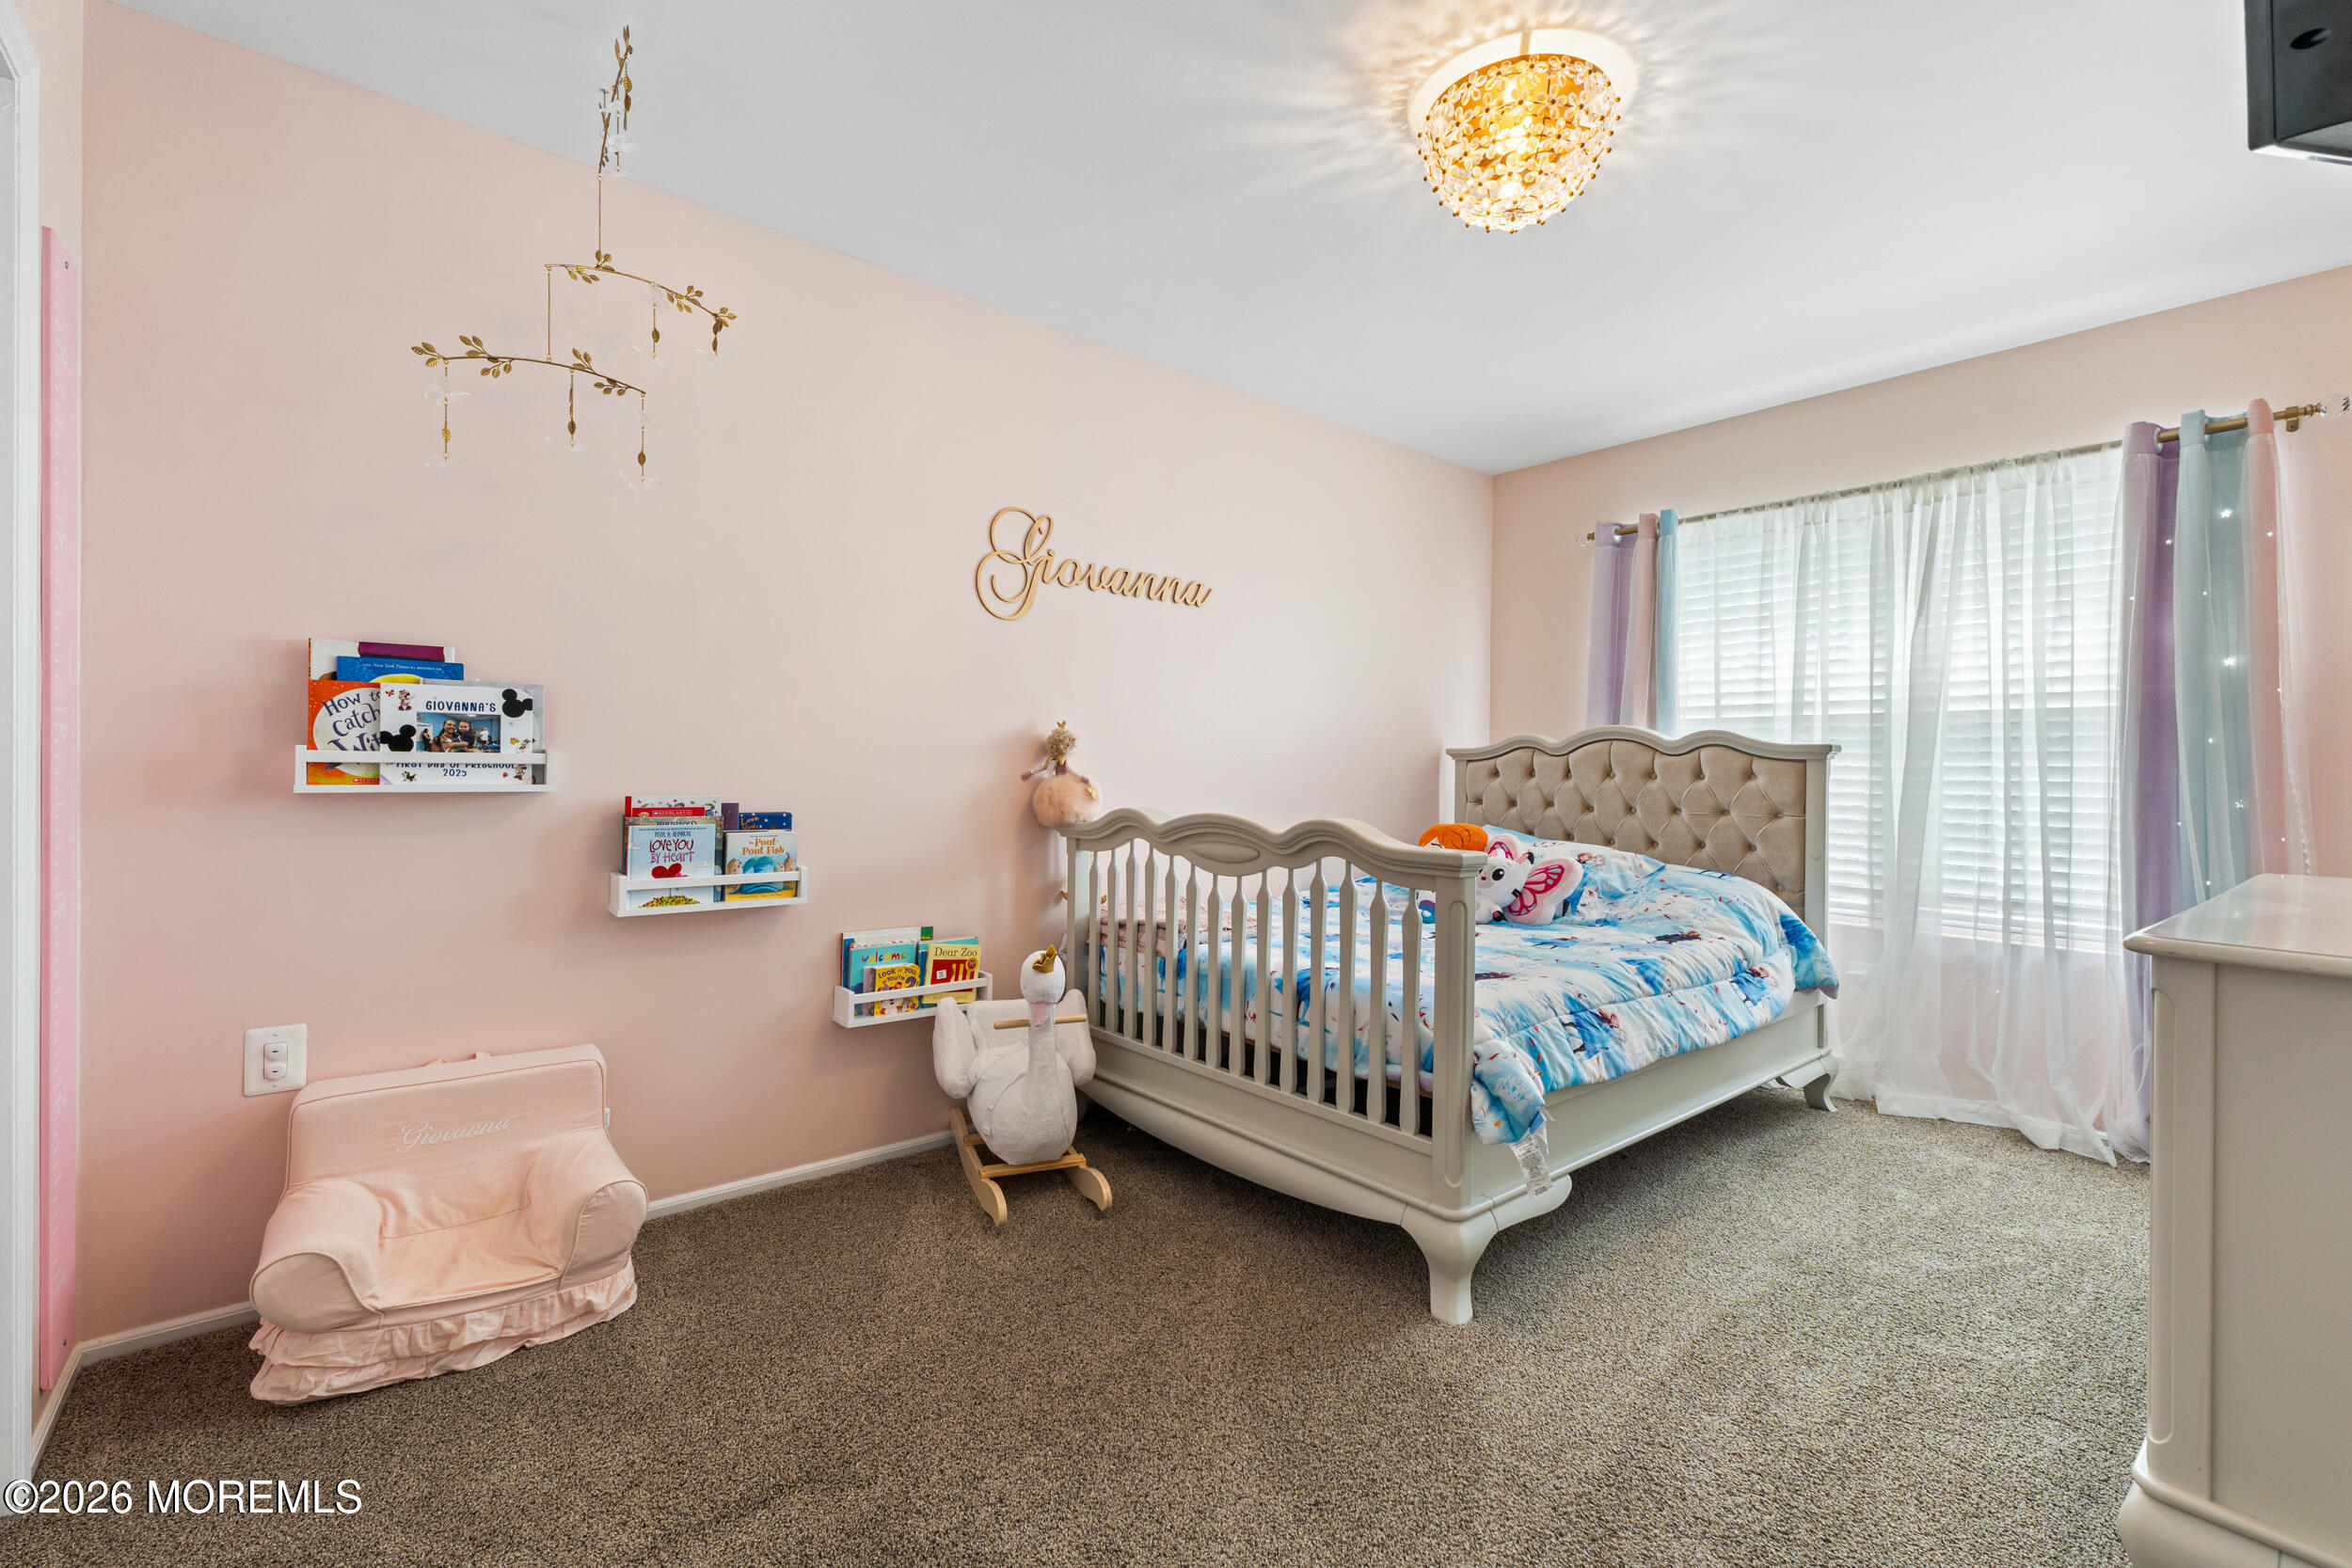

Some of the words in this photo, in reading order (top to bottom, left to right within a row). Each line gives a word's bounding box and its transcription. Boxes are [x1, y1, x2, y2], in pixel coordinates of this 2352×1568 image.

[976, 506, 1213, 621] Giovanna
[322, 693, 361, 717] How
[425, 700, 497, 713] GIOVANNA'S
[332, 703, 381, 737] Catch
[442, 768, 468, 777] 2025
[673, 838, 694, 852] YOU
[742, 846, 763, 856] Pout
[767, 845, 785, 855] Fish
[650, 852, 661, 864] BY
[934, 946, 959, 957] Dear
[961, 947, 977, 958] Zoo
[396, 1117, 513, 1152] Giovanna
